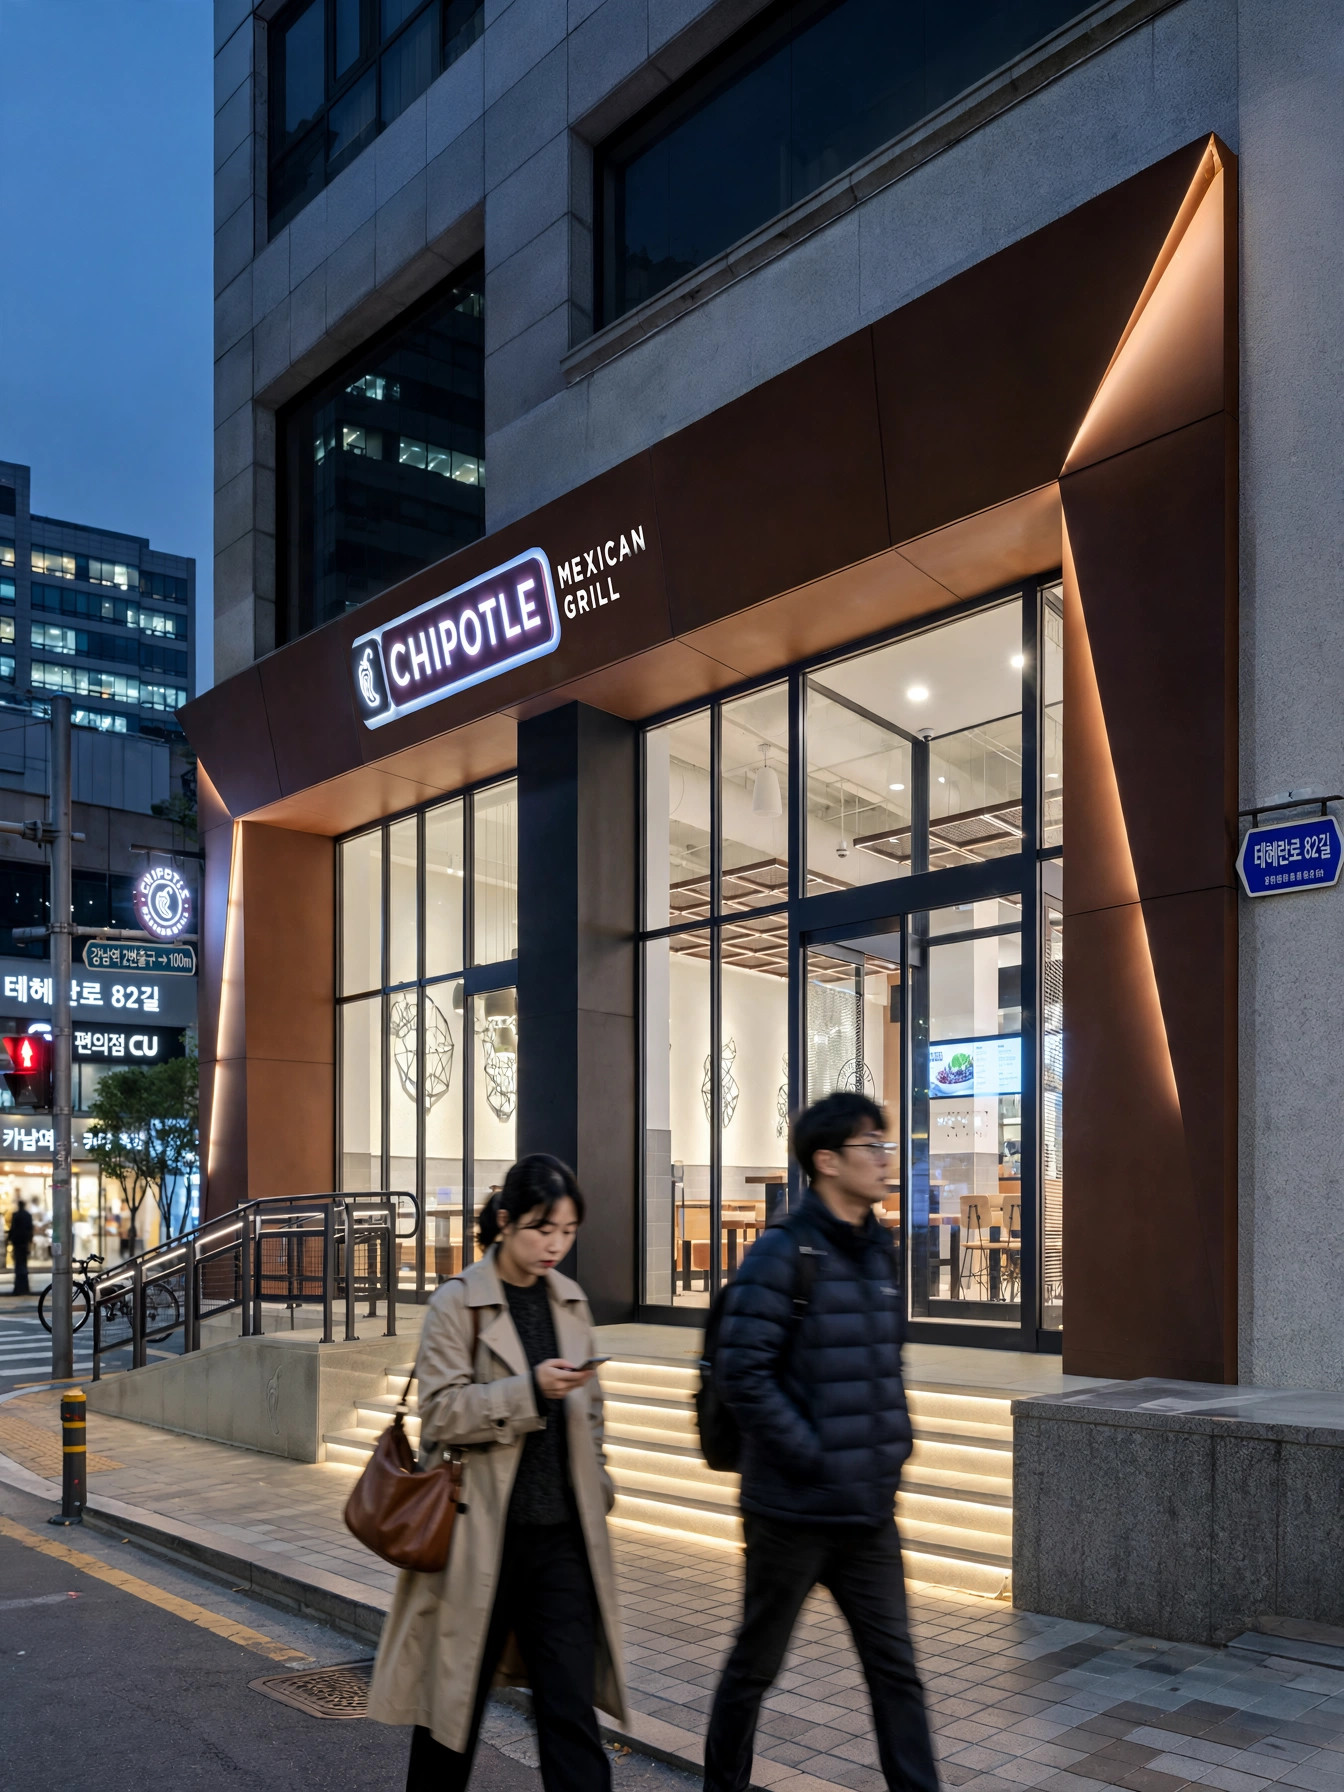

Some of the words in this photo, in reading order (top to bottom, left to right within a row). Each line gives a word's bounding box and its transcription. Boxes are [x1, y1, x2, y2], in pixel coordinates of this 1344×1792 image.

[557, 525, 647, 589] MEXICAN
[564, 576, 621, 619] GRILL
[390, 578, 542, 687] CHIPOTLE
[1254, 838, 1302, 868] 테헤란로
[1304, 832, 1331, 860] 82길
[91, 947, 120, 966] 강남역
[168, 953, 192, 968] 100m
[111, 984, 160, 1012] 82길
[74, 1031, 125, 1056] 편의점
[129, 1034, 159, 1057] CU
